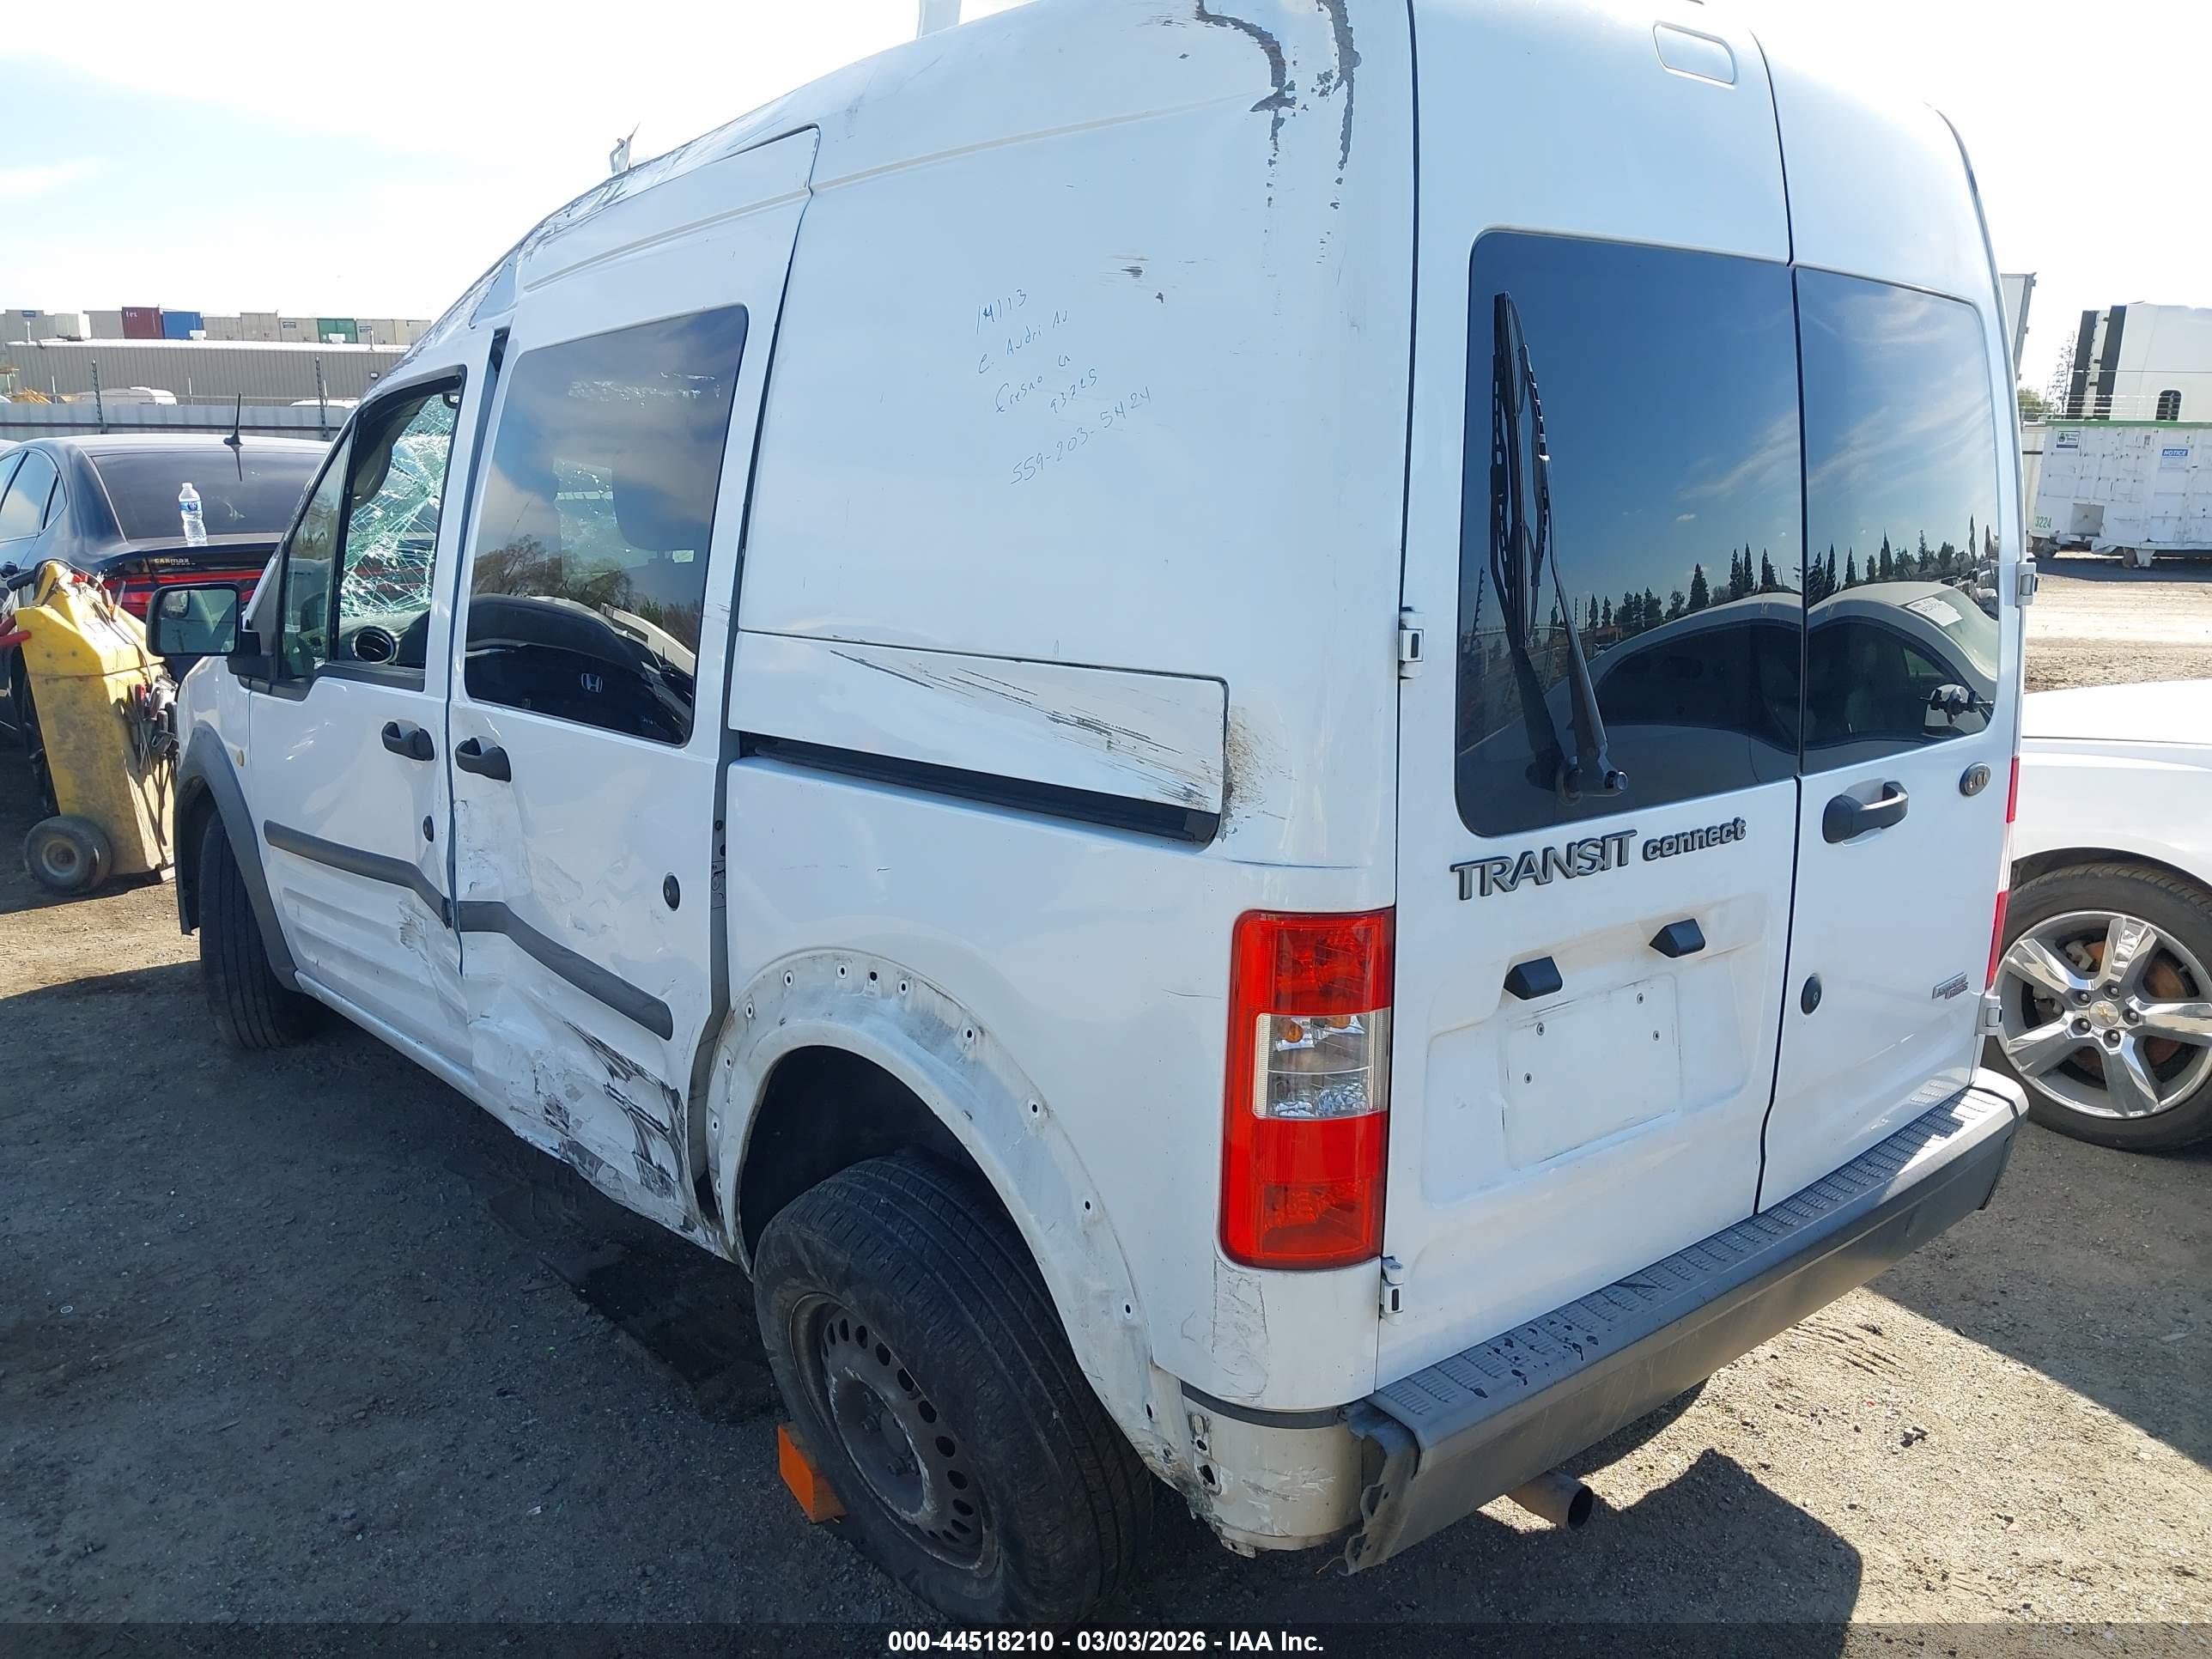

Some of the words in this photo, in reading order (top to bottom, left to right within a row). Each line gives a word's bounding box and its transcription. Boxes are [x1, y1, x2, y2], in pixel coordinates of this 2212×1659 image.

[1011, 386, 1151, 484] 559-203-5424
[2035, 516, 2051, 529] 3224
[1449, 829, 1638, 901] TRANSIT
[1642, 817, 1747, 861] connect
